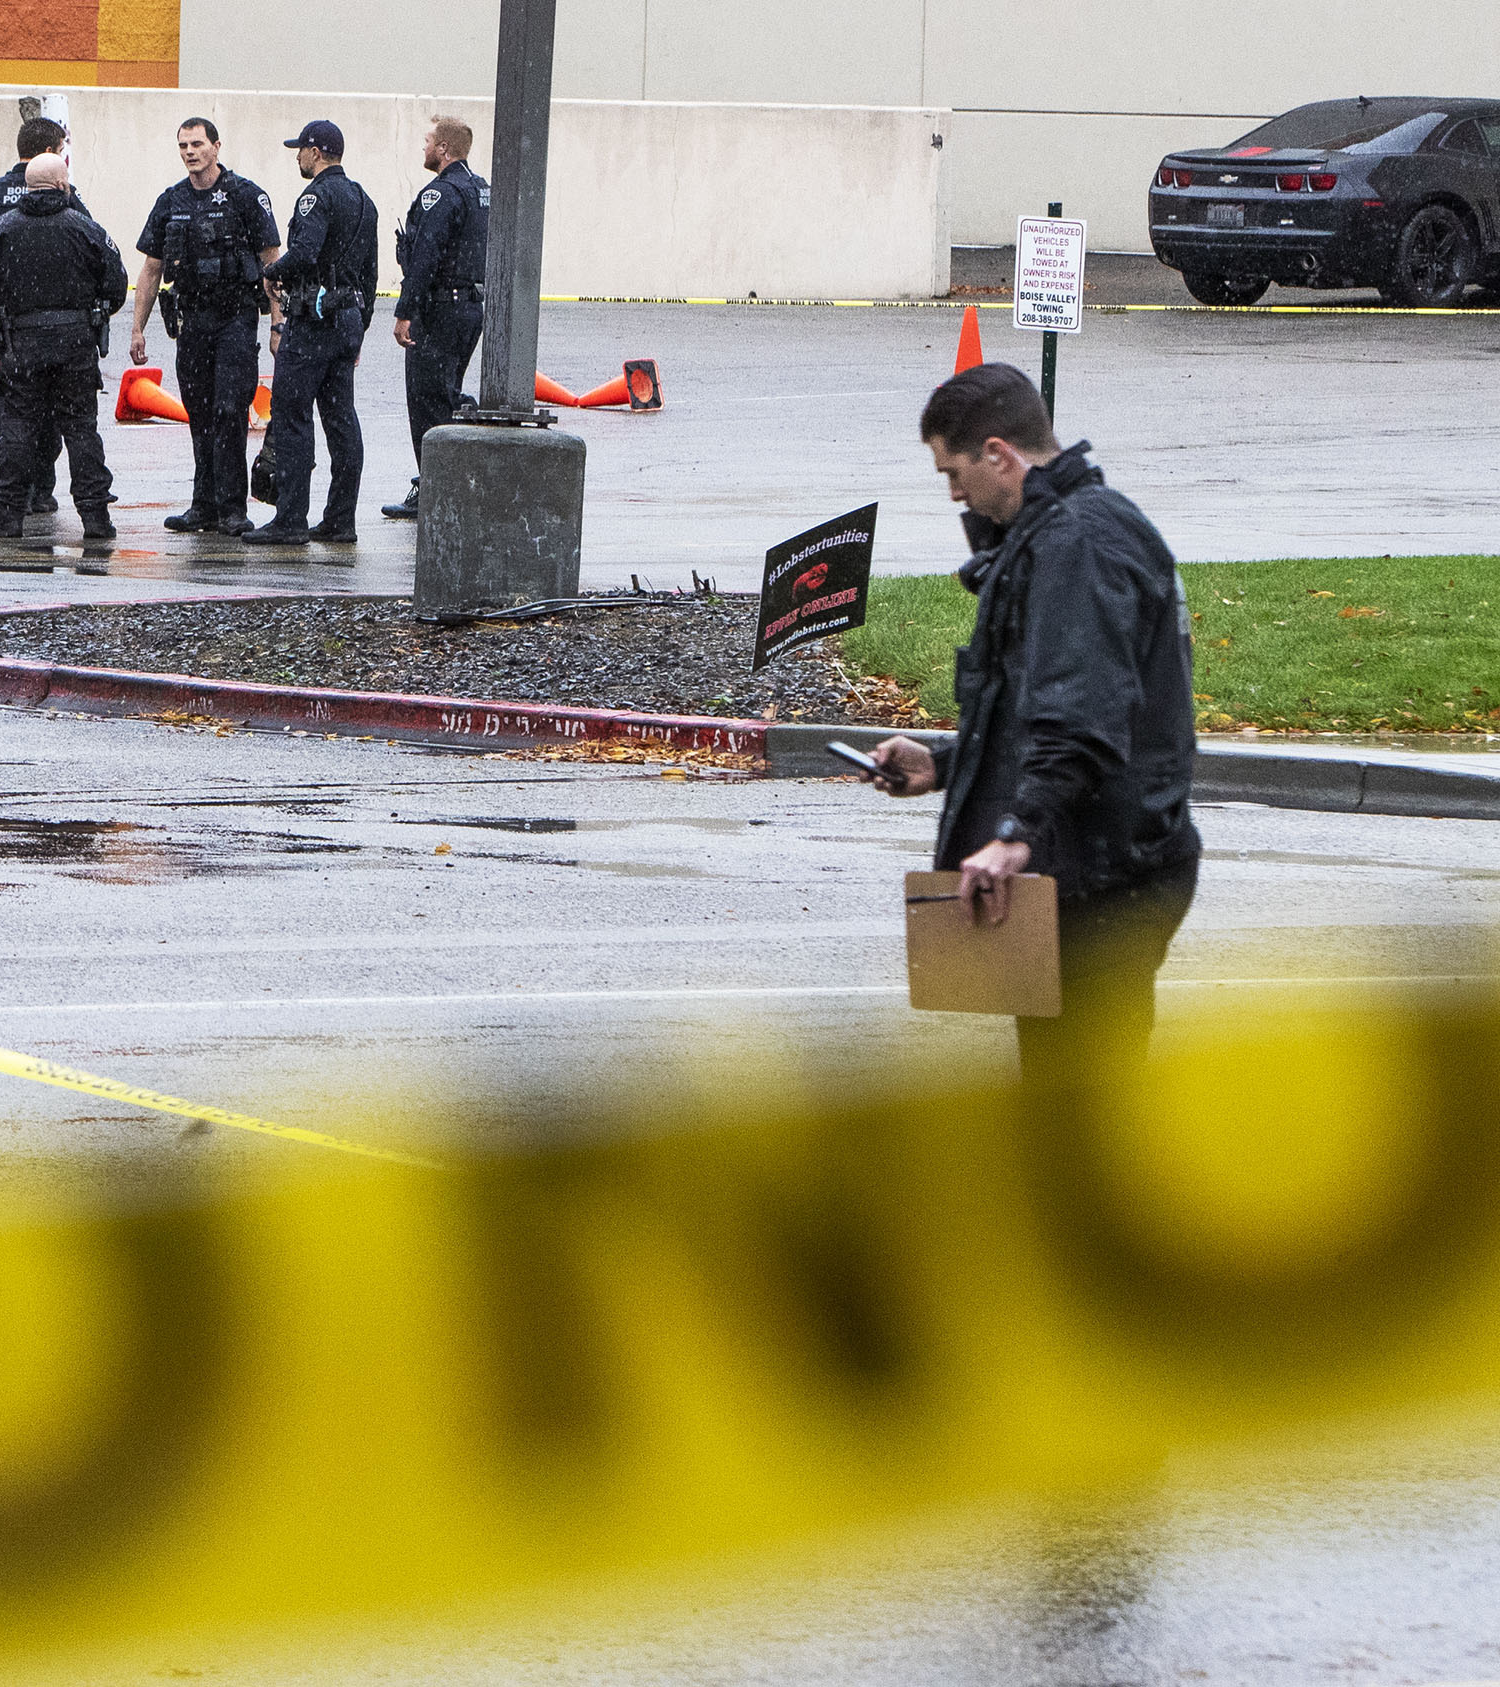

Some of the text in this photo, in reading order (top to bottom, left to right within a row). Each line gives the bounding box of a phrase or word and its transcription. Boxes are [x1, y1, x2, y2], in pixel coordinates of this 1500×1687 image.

[7, 186, 29, 195] BOI
[1023, 224, 1081, 236] UNAUTHORIZED
[1033, 236, 1070, 247] VEHICLES
[1035, 248, 1065, 257] WILL BE
[1032, 258, 1069, 268] TOWED AT
[1023, 268, 1076, 280] OWNER'S RISK
[1023, 279, 1075, 291] AND EXPENSE
[1020, 291, 1077, 304] BOISE VALLEY
[1032, 303, 1064, 314] TOWING
[1022, 313, 1073, 325] 208-389-9707
[767, 528, 869, 587] #Lobstertunities
[763, 587, 858, 640] APPLY ONLINE
[765, 615, 849, 657] www.redlobster.com
[460, 995, 1500, 1490] NO
